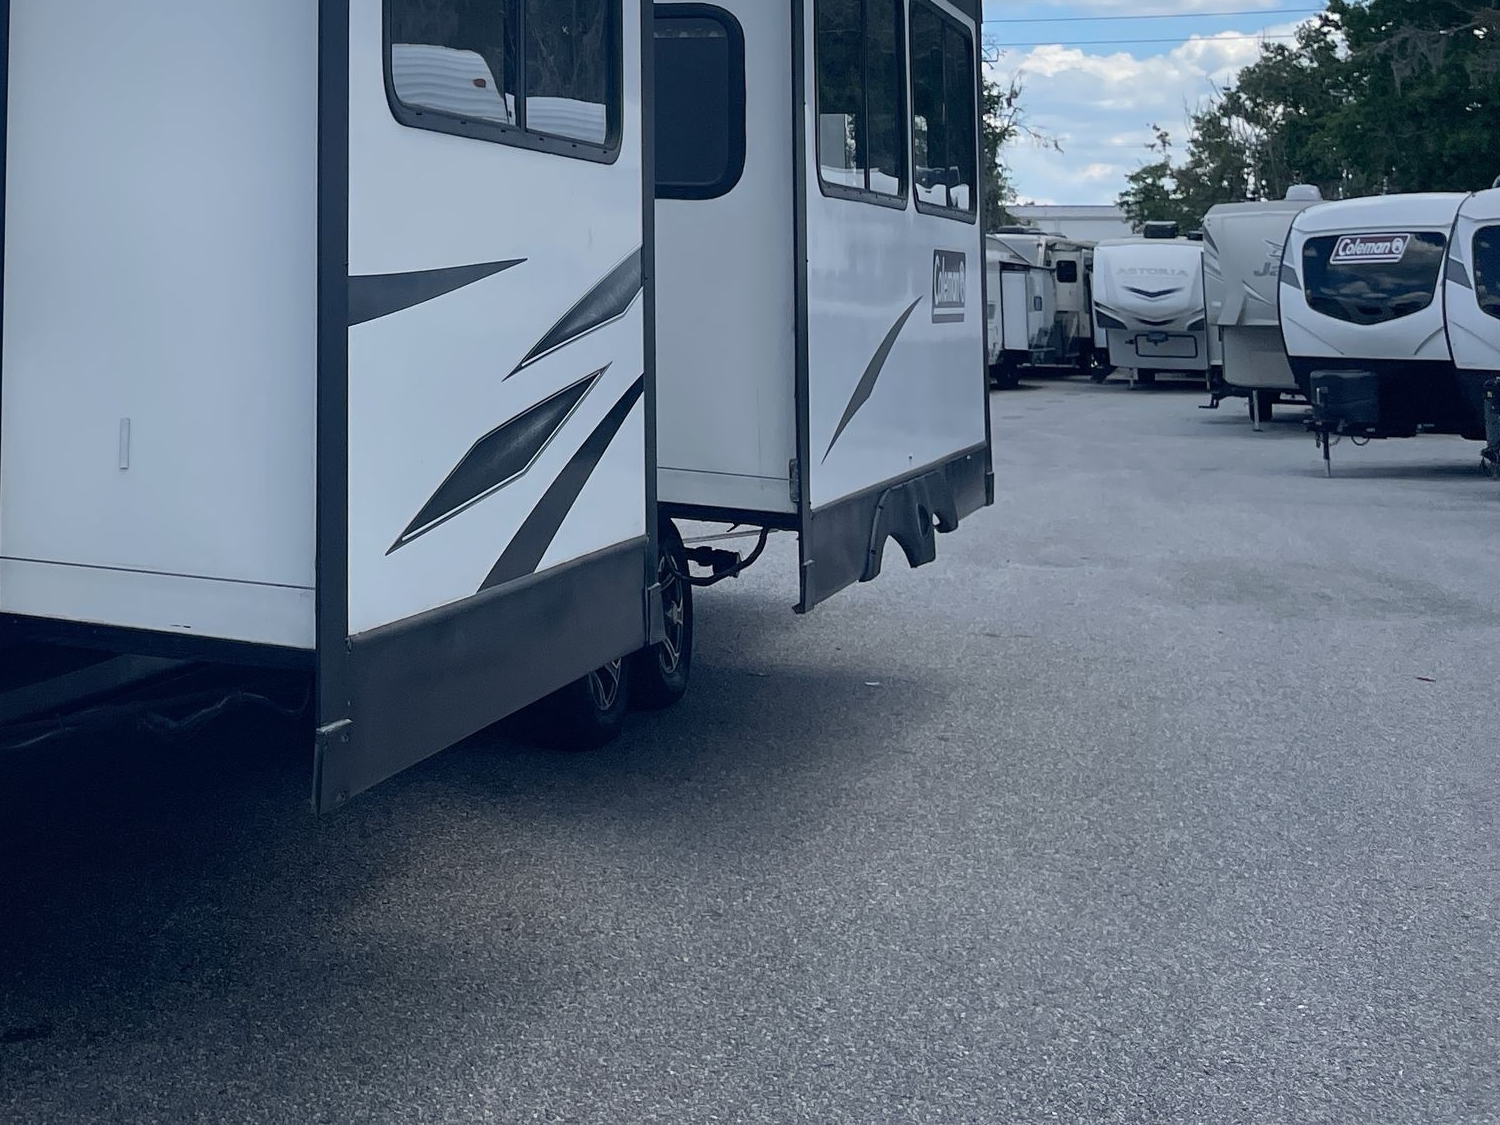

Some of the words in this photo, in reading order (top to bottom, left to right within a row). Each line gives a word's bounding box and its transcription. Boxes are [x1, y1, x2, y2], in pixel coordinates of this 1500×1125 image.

[1338, 238, 1391, 256] Coleman
[934, 254, 960, 306] Coleman
[1117, 267, 1189, 277] ASTORIA
